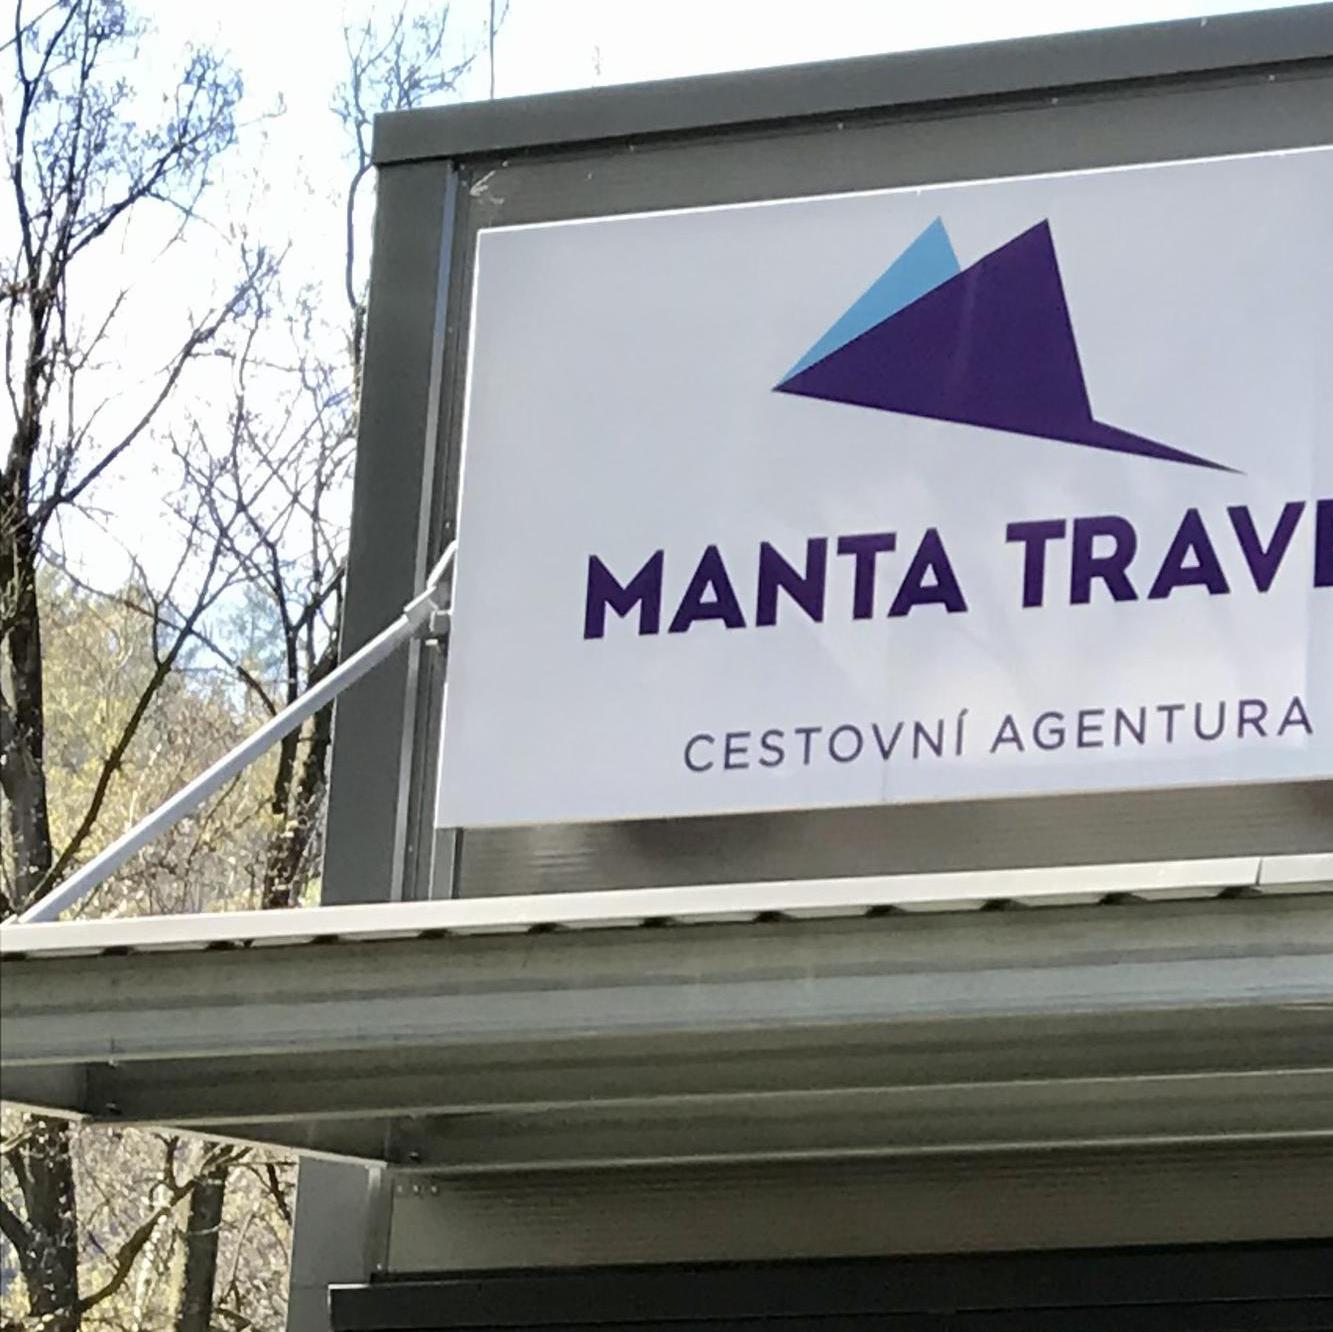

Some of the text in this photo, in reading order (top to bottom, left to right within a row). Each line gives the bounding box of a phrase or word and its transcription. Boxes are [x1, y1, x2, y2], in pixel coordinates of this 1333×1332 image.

[582, 525, 967, 640] MANTA
[682, 695, 1315, 773] CESTOVNÍ AGENTURA
